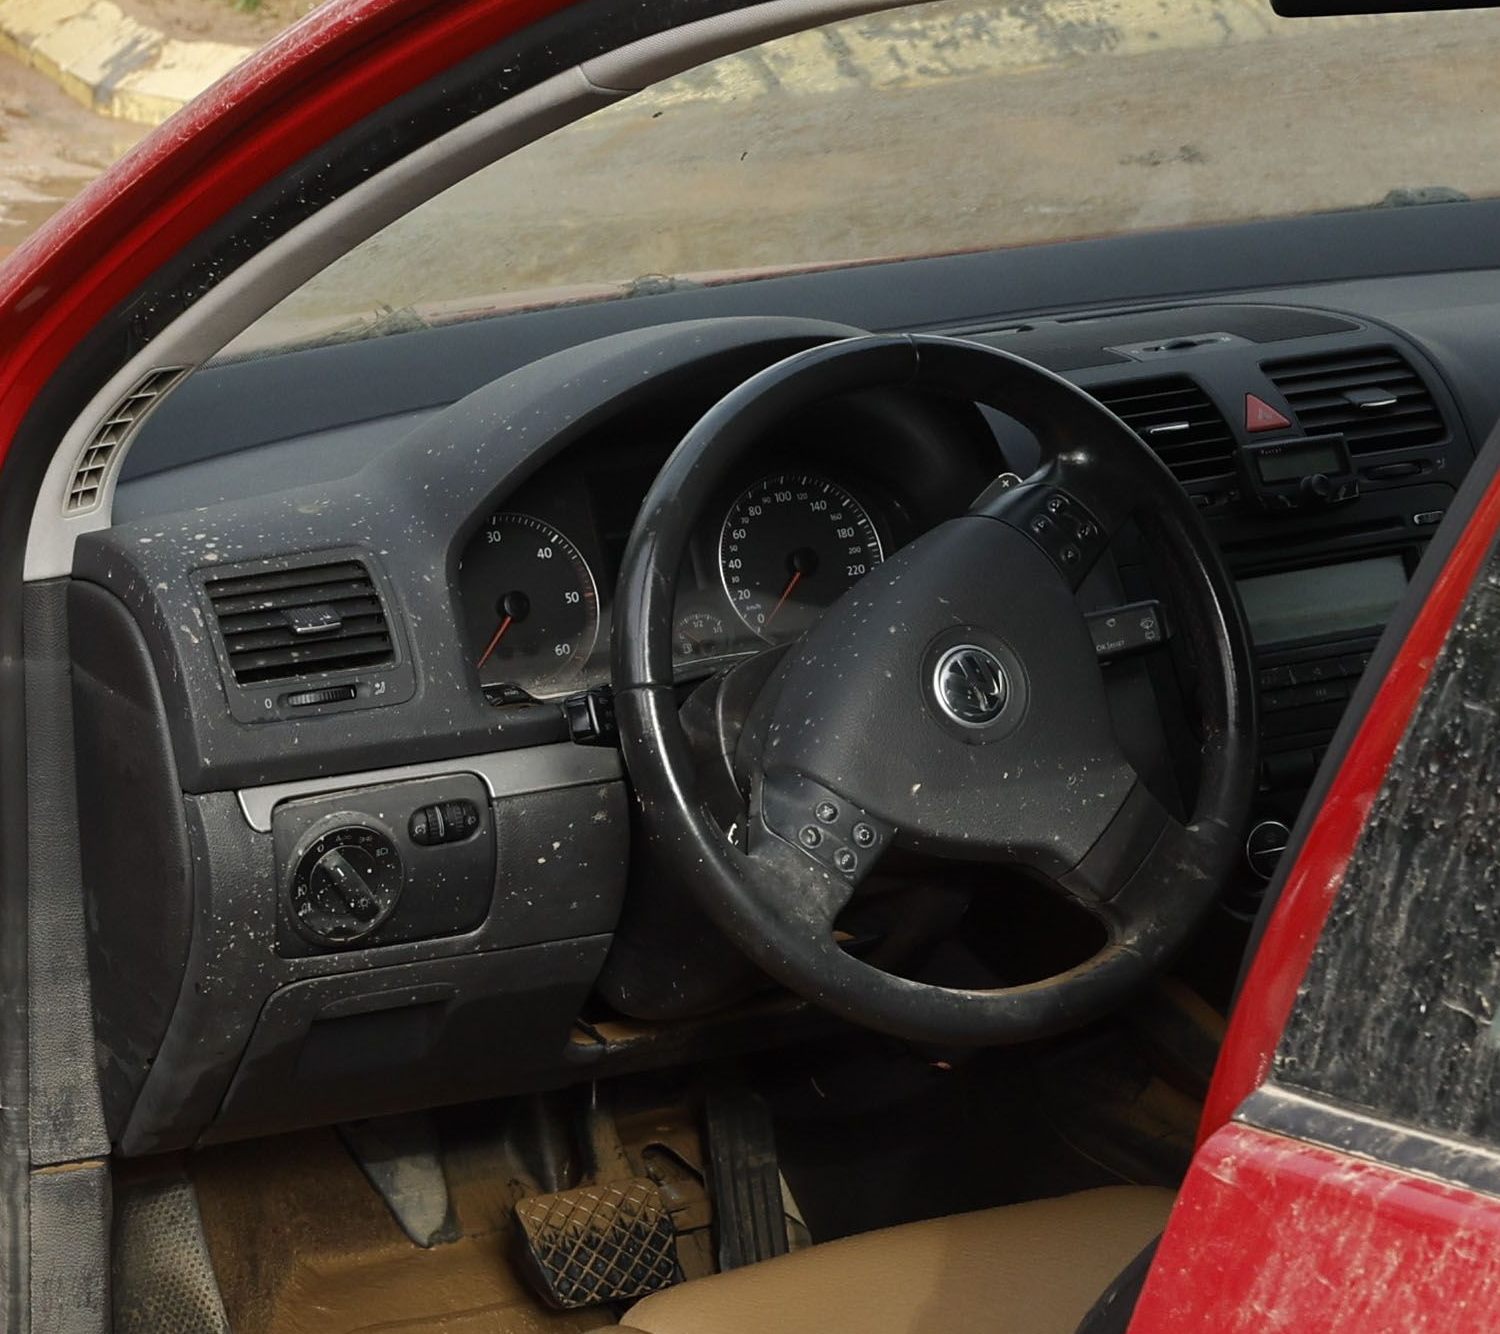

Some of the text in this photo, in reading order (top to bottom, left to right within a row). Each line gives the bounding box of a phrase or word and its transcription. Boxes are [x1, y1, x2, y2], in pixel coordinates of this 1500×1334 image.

[774, 490, 792, 503] 100
[748, 504, 762, 516] 80
[810, 499, 827, 512] 140
[486, 529, 501, 544] 30
[732, 528, 746, 539] 60
[836, 526, 855, 539] 180
[536, 546, 553, 560] 40
[728, 558, 742, 569] 40
[847, 563, 865, 576] 220
[565, 590, 579, 604] 50
[737, 588, 751, 601] 20
[757, 612, 765, 624] 0
[554, 642, 571, 657] 60
